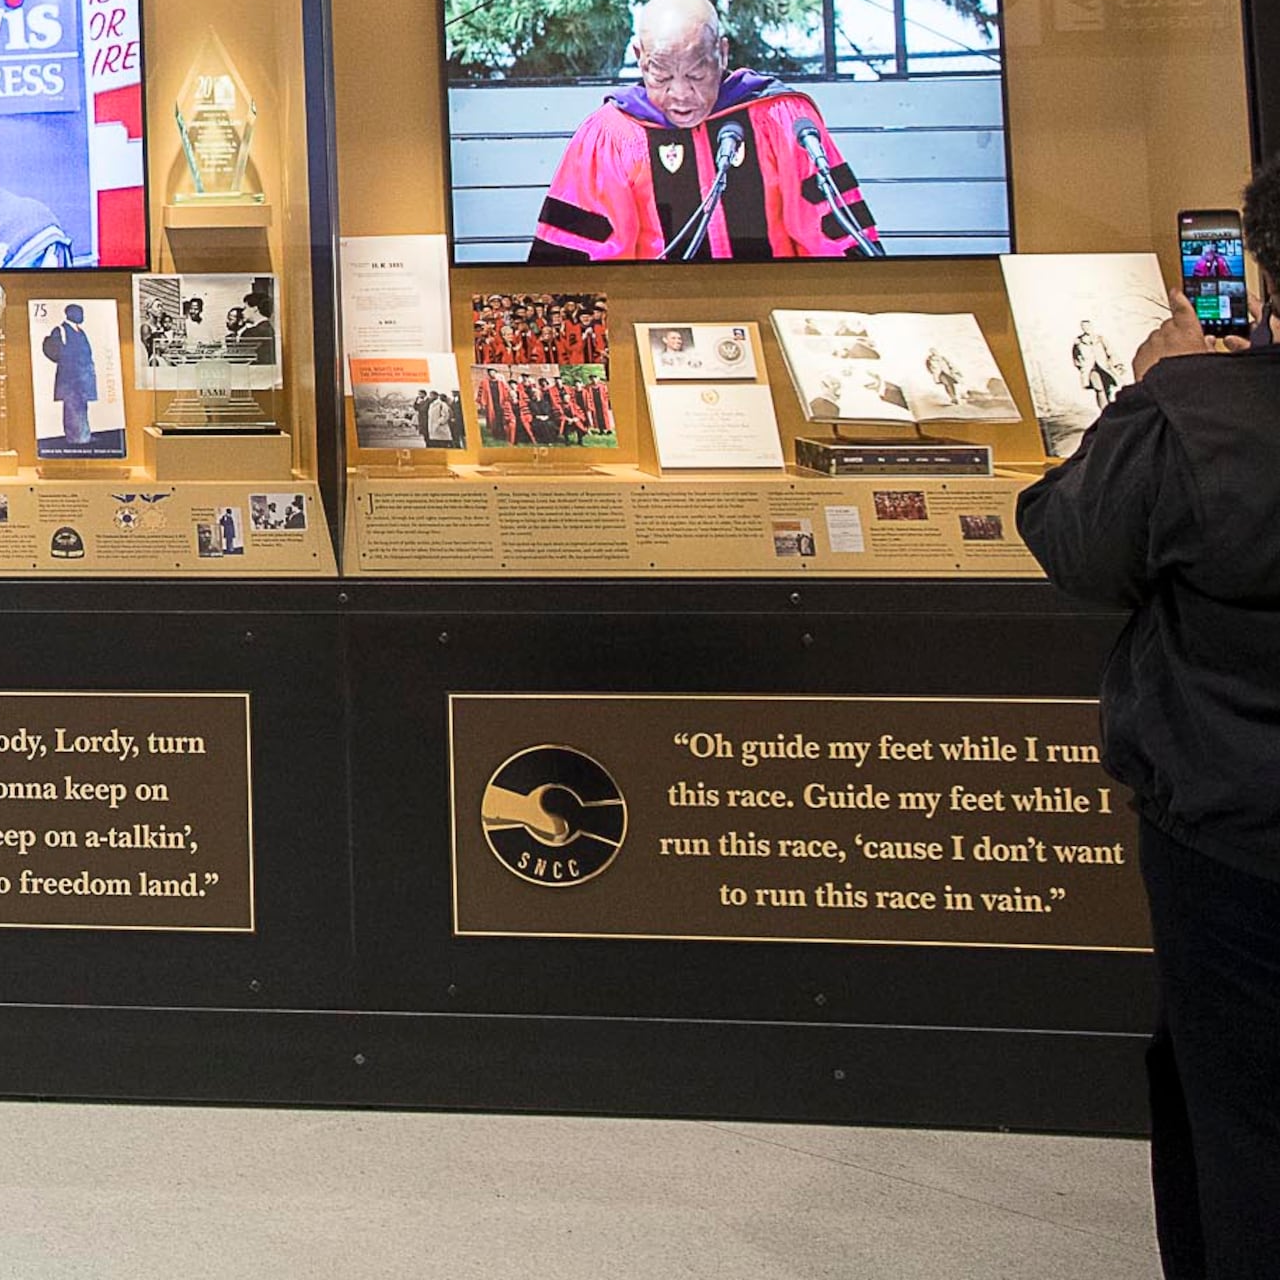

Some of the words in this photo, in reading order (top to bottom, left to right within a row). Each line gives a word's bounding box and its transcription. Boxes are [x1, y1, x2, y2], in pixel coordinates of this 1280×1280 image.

[33, 304, 47, 318] 75
[55, 728, 138, 760] Lordy,
[148, 733, 206, 753] turn
[674, 733, 734, 757] "Oh
[742, 734, 820, 766] guide
[828, 742, 871, 768] my
[878, 735, 933, 760] feet
[939, 736, 1016, 761] while
[1025, 737, 1038, 762] I
[1046, 745, 1100, 762] run
[64, 776, 126, 808] keep
[136, 784, 169, 800] on
[668, 782, 719, 806] this
[726, 790, 794, 808] race.
[804, 783, 890, 809] Guide
[898, 793, 942, 818] my
[949, 786, 1005, 811] feet
[1011, 787, 1090, 812] while
[1098, 788, 1111, 813] I
[45, 831, 78, 847] on
[86, 824, 197, 854] a-talkin',
[660, 838, 710, 855] run
[718, 832, 770, 856] this
[778, 840, 846, 862] race,
[855, 834, 942, 860] 'cause
[951, 836, 964, 860] I
[974, 836, 1047, 862] don't
[1053, 844, 1124, 864] want
[517, 852, 581, 879] SNCC
[20, 870, 132, 895] freedom
[139, 872, 218, 896] land."
[720, 885, 747, 905] to
[756, 890, 807, 906] run
[815, 883, 868, 908] this
[876, 892, 936, 909] race
[944, 885, 974, 910] in
[980, 887, 1065, 912] vain."
